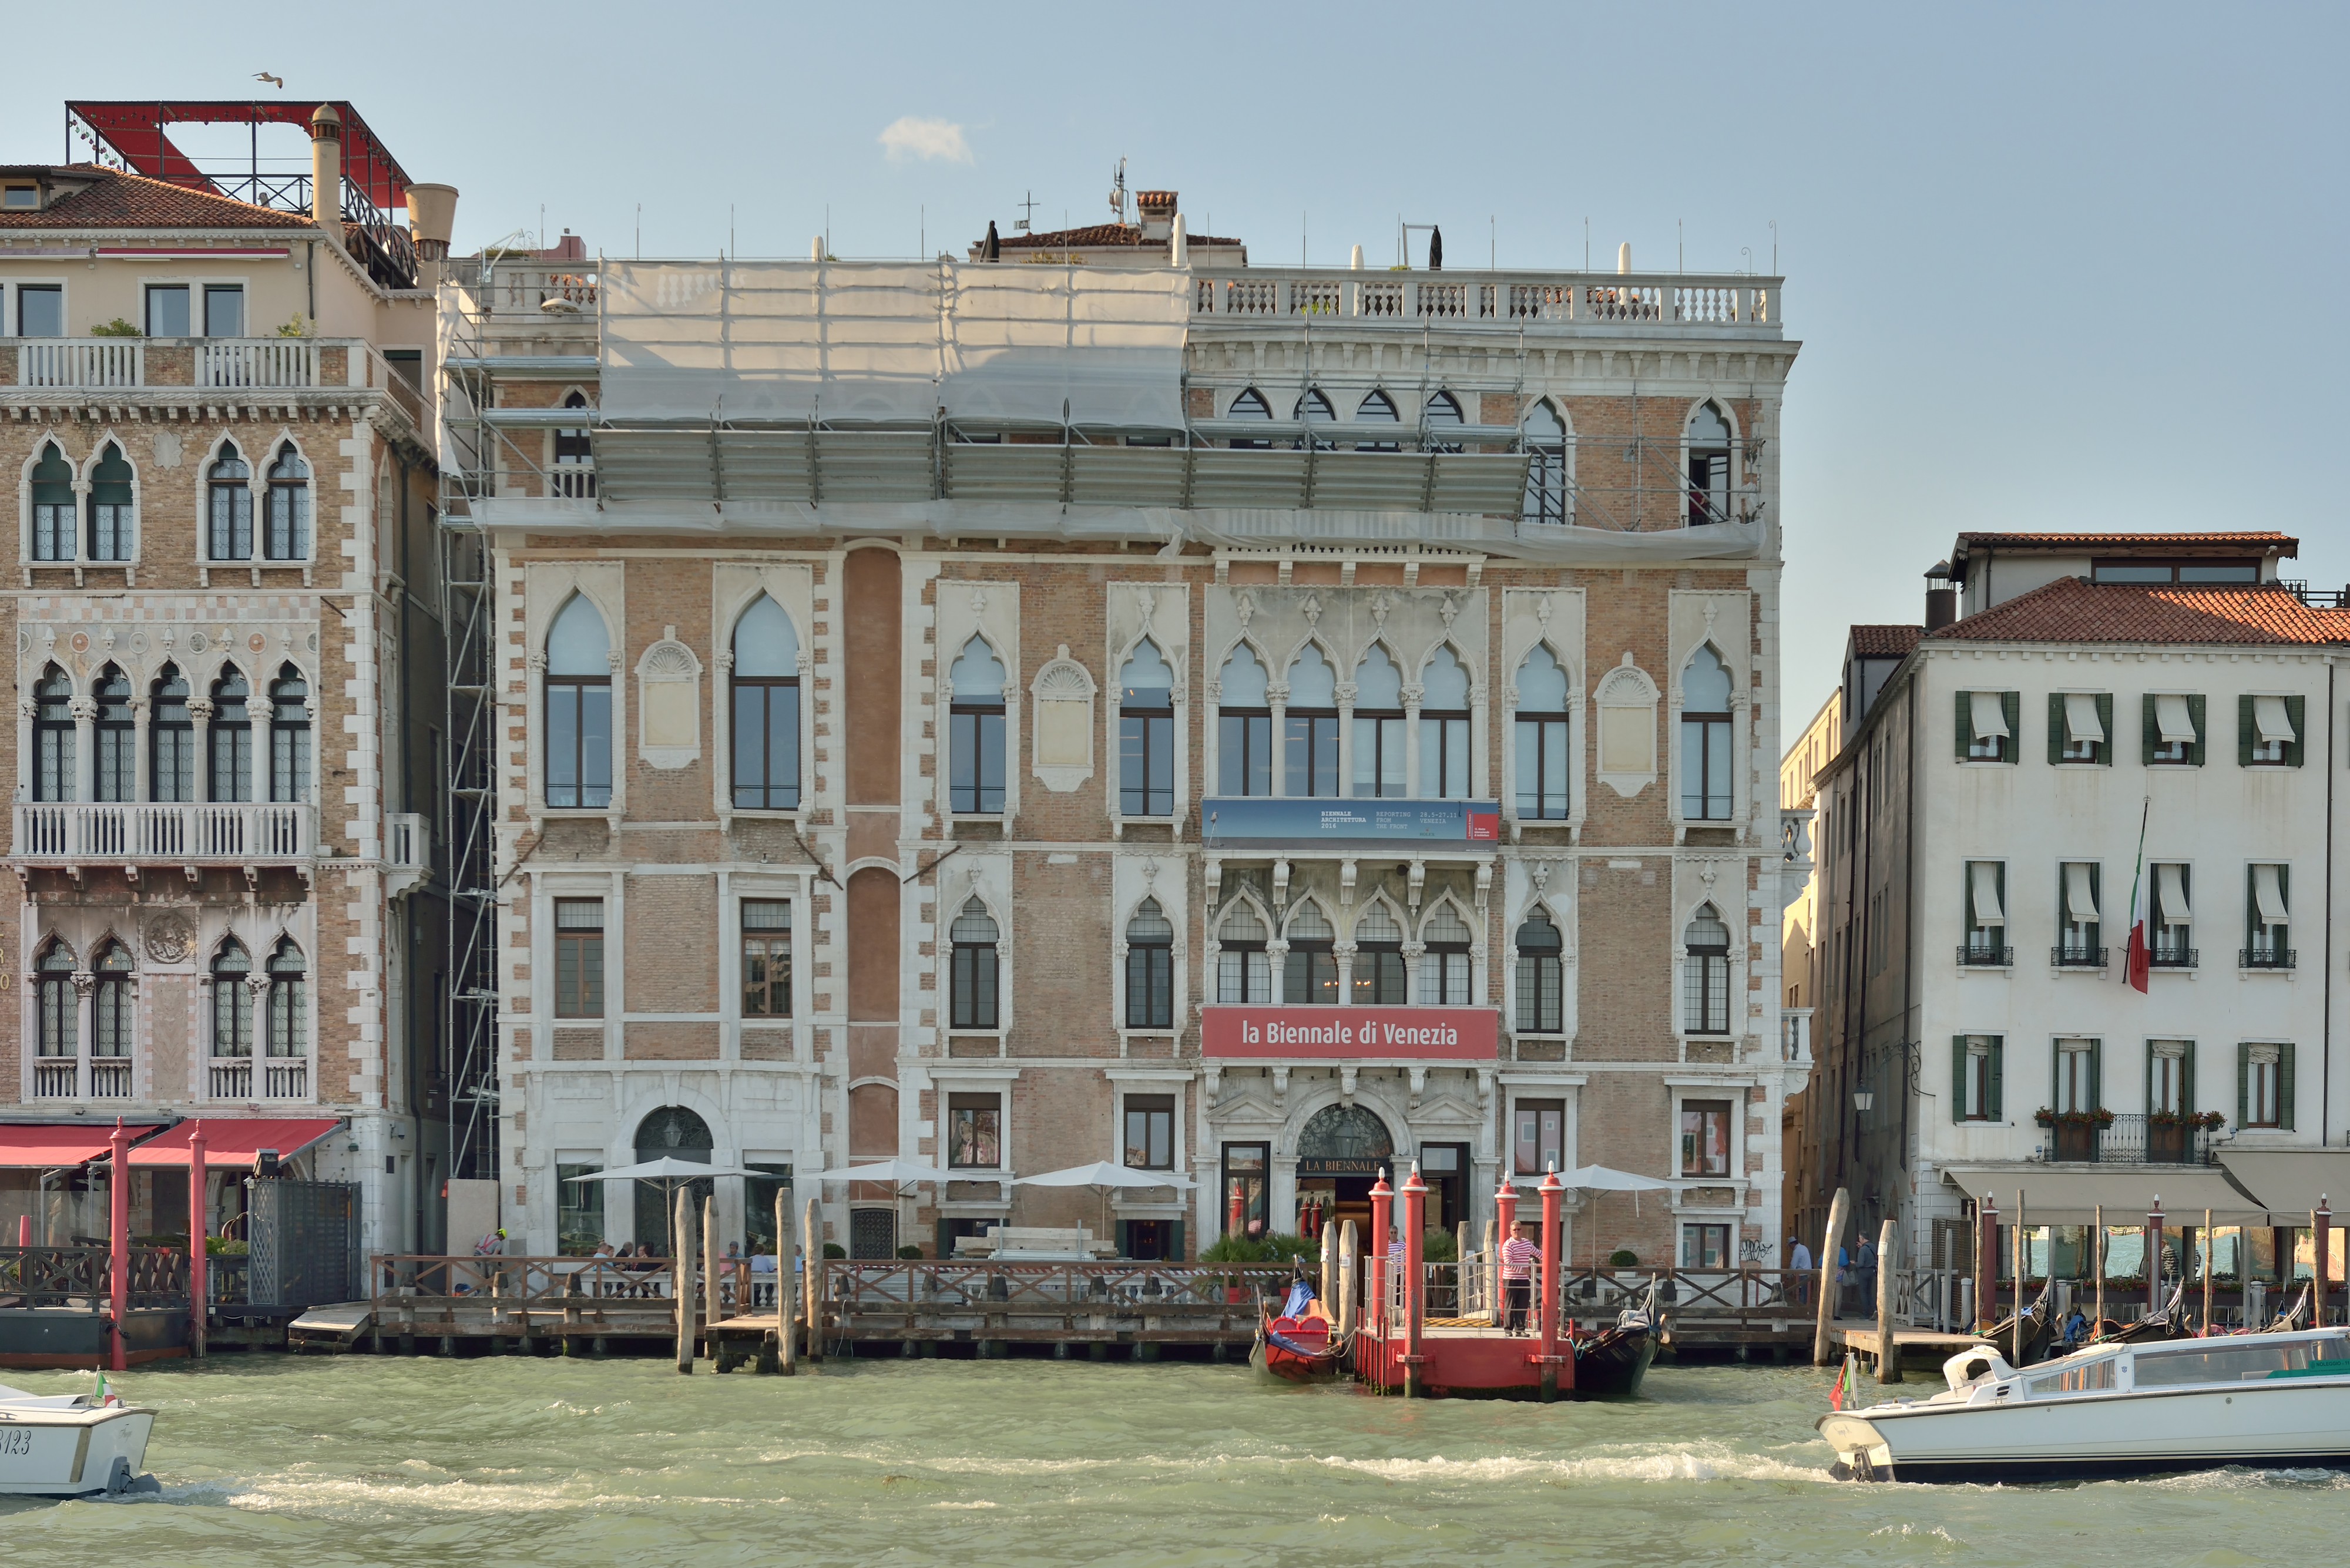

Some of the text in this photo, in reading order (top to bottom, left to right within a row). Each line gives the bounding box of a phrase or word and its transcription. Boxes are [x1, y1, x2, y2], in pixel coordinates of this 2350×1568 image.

[1243, 1020, 1458, 1045] la Biennale di Venezia
[1306, 1160, 1380, 1171] LA BIENNALE
